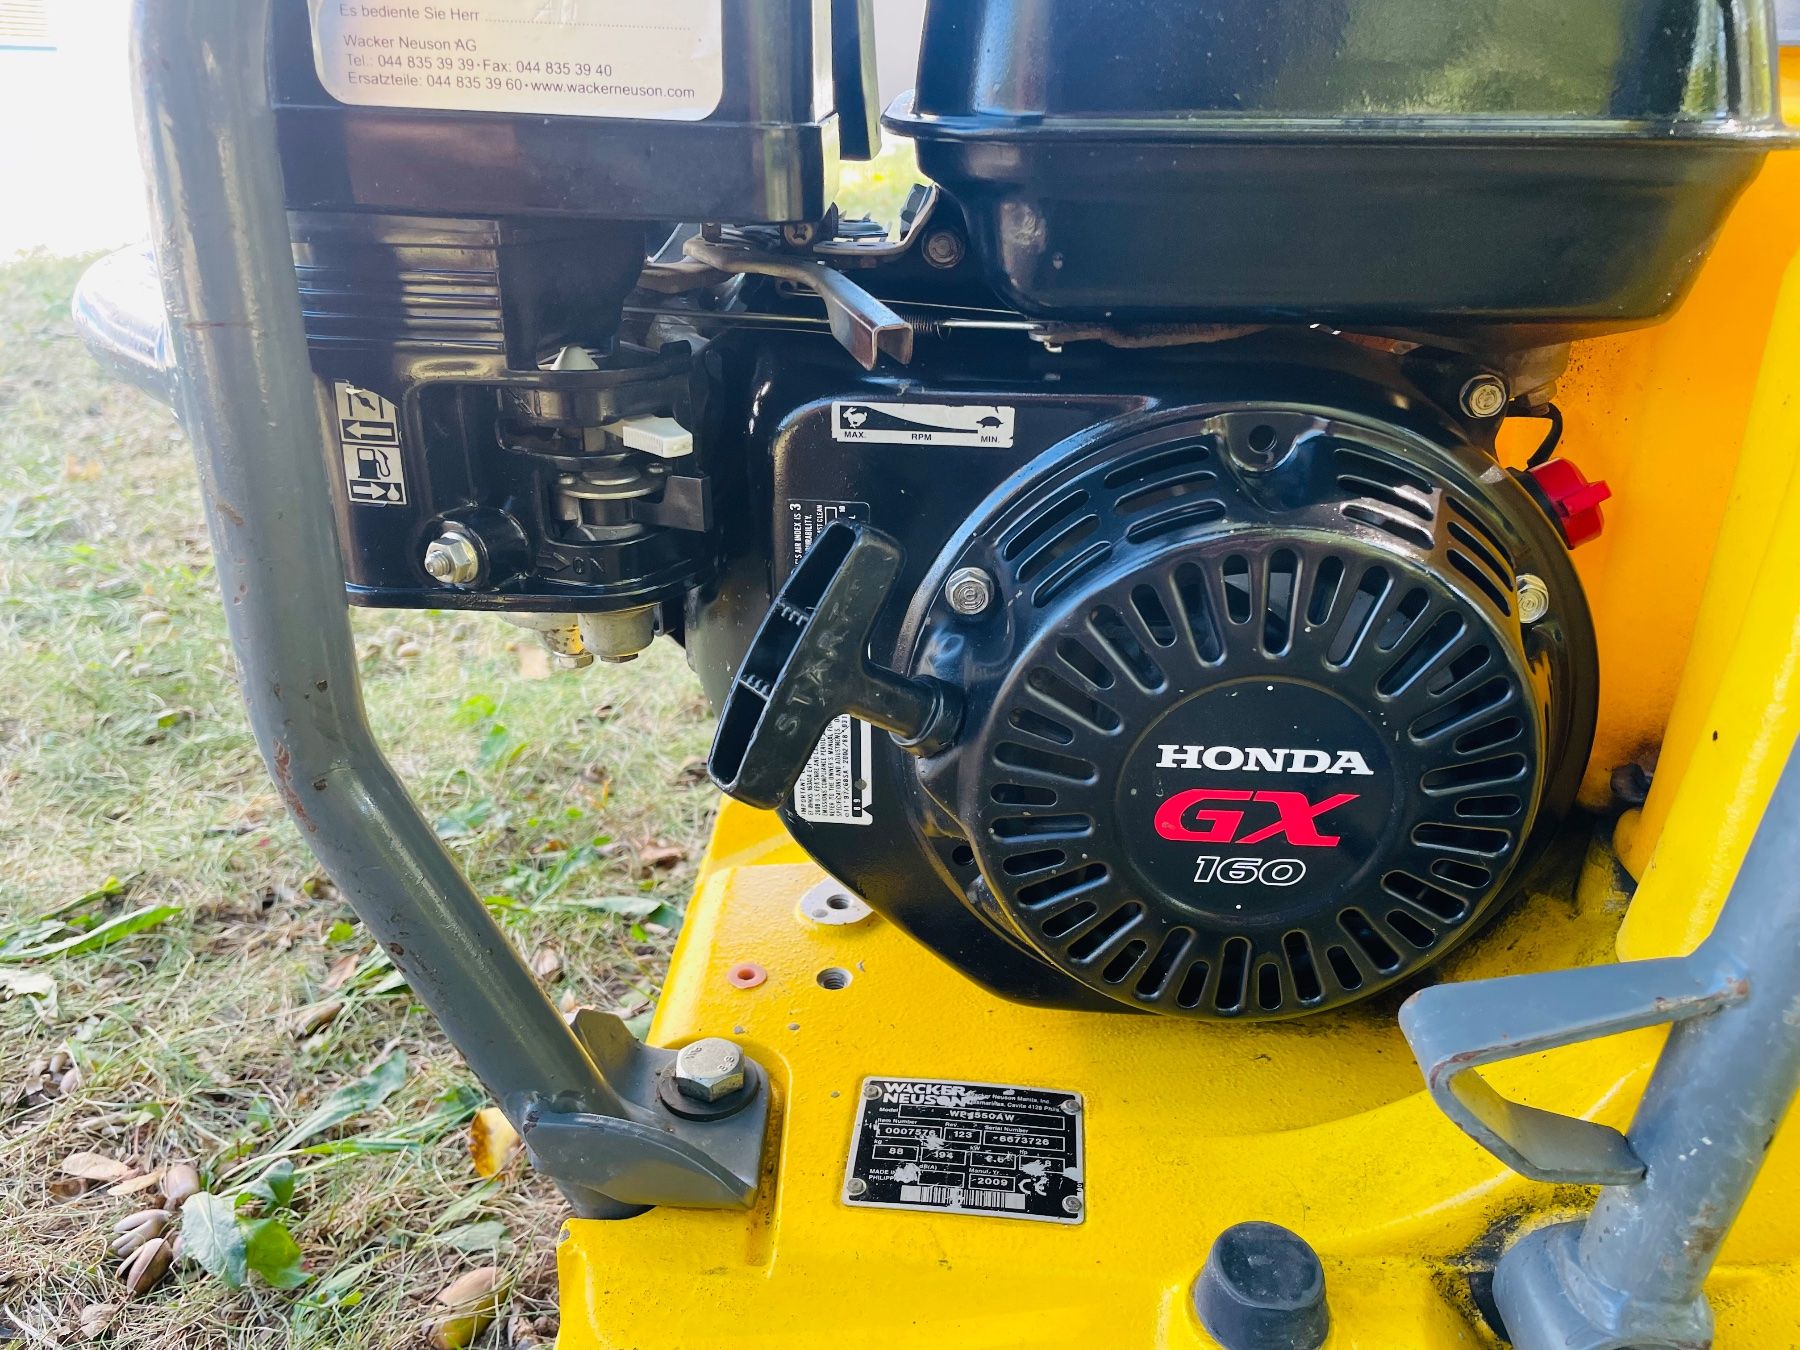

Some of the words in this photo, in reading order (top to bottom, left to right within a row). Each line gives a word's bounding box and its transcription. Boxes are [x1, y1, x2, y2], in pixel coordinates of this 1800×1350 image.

[339, 4, 357, 17] Es
[361, 4, 420, 20] bediente
[424, 7, 447, 20] Sie
[450, 8, 480, 22] Herr
[343, 34, 395, 48] Wacker
[399, 36, 451, 51] Neuson
[456, 39, 477, 52] AG
[377, 55, 402, 68] 044
[407, 56, 433, 70] 835
[436, 57, 453, 70] 39
[516, 60, 540, 74] 044
[545, 62, 571, 75] 835
[575, 63, 591, 76] 39
[595, 64, 613, 77] 40
[348, 72, 422, 87] Ersatzteile:
[426, 74, 451, 87] 044
[456, 75, 481, 89] 835
[485, 77, 502, 90] 39
[844, 430, 867, 439] MAX.
[911, 433, 933, 441] RPM
[789, 503, 801, 511] 3
[794, 522, 802, 541] INDEX
[826, 734, 834, 755] MANUAL
[1155, 744, 1374, 775] HONDA
[820, 758, 828, 789] COMPLIANCE
[827, 757, 835, 781] OWNER'S
[834, 765, 842, 776] AND
[1154, 788, 1361, 847] GX
[1193, 855, 1307, 887] 160
[884, 1083, 966, 1097] WACKER
[882, 1093, 967, 1108] NEUSON
[1007, 1102, 1027, 1110] Cavite
[953, 1130, 973, 1139] 123
[1003, 1126, 1029, 1134] Number
[888, 1147, 904, 1155] 88
